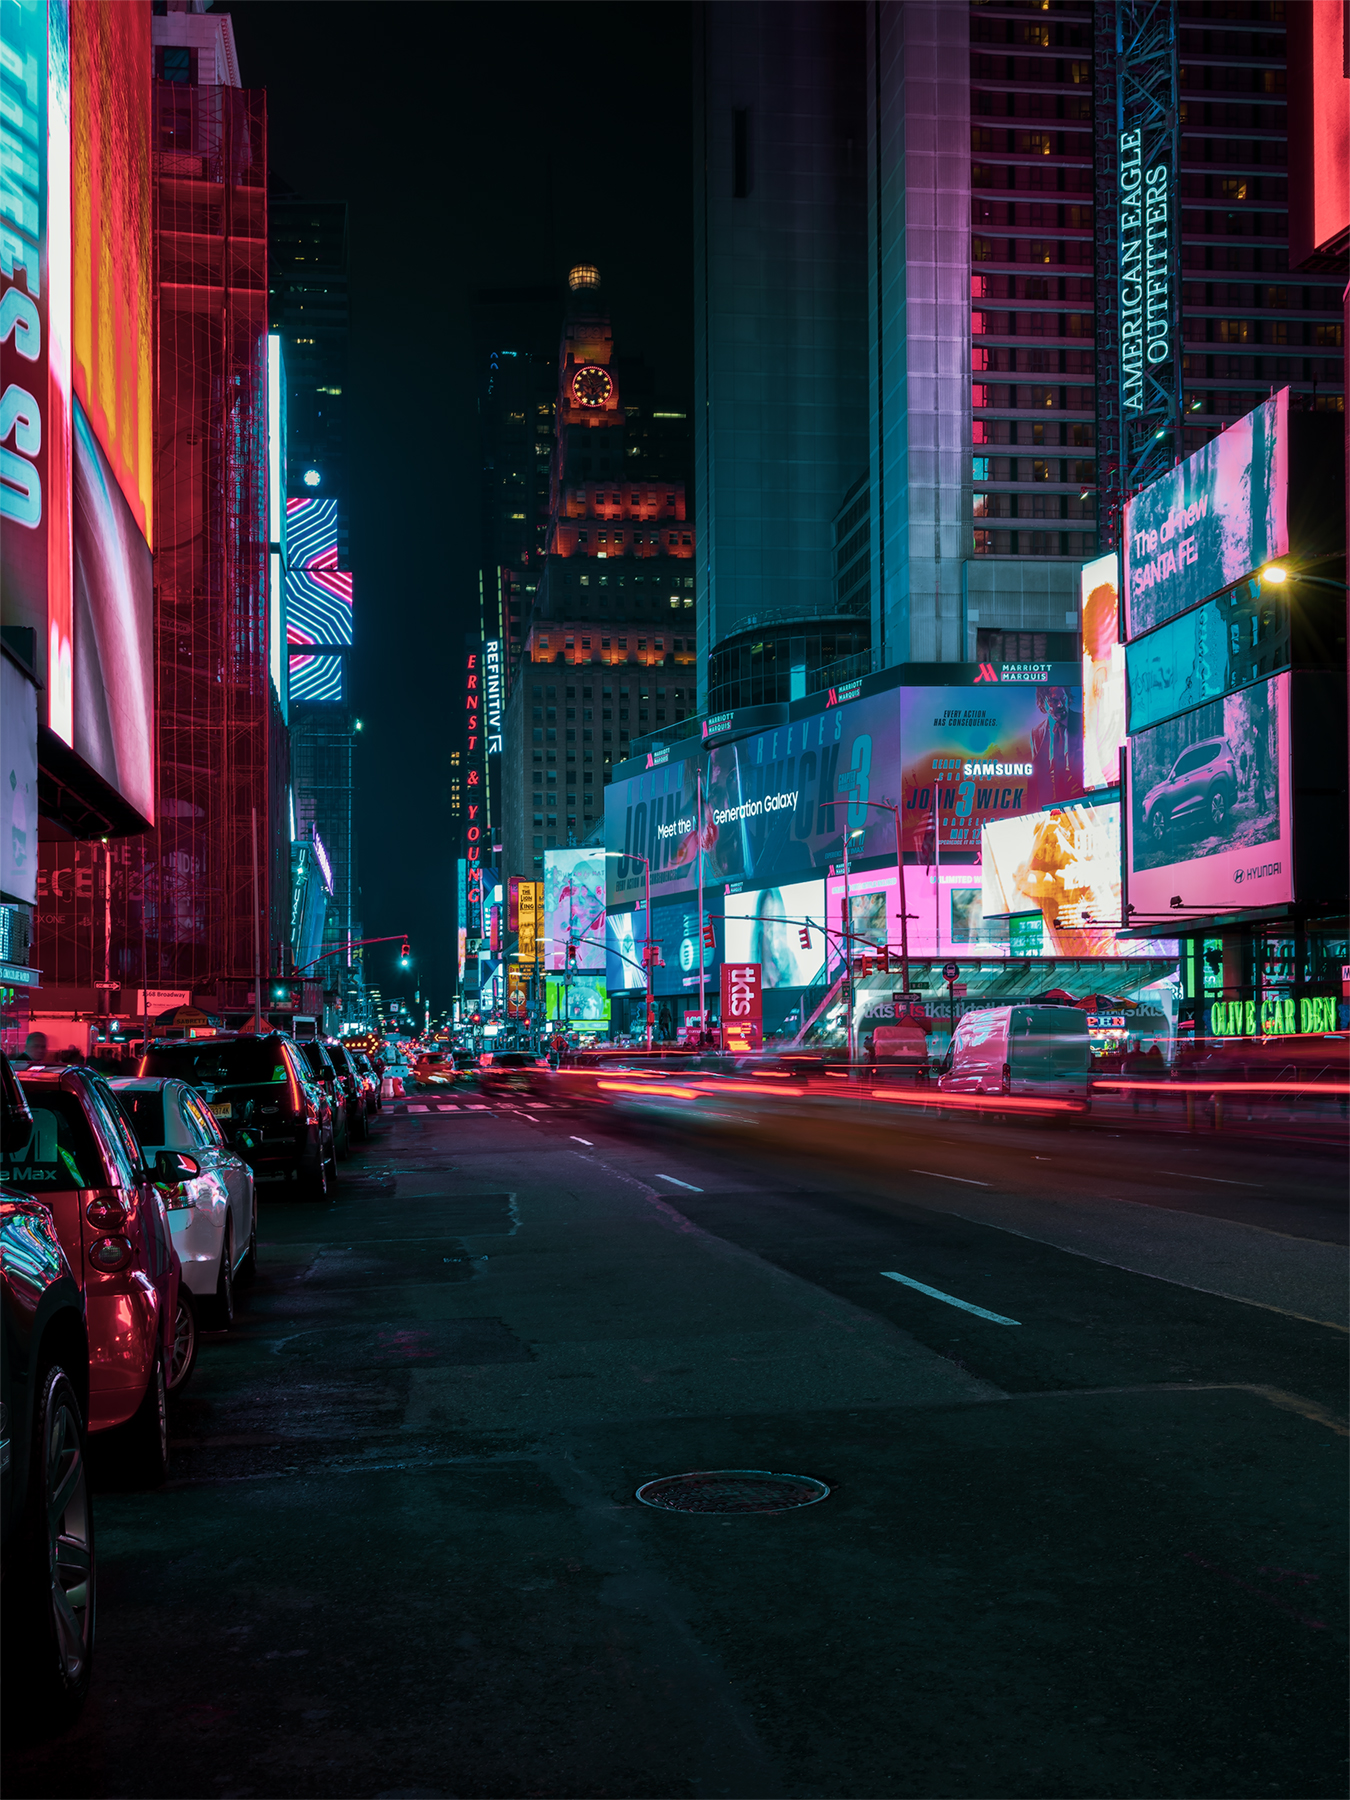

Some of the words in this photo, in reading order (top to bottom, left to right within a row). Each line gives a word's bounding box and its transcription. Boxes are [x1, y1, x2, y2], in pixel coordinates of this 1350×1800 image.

[1121, 128, 1143, 234] EAGLE
[1146, 165, 1169, 364] OUTFITTERS
[1122, 242, 1144, 411] AMERICAN
[1134, 529, 1158, 559] The
[1160, 494, 1209, 544] all-new
[1134, 548, 1177, 595] SANTA
[1178, 534, 1199, 571] FE
[1002, 664, 1053, 672] MARRIOTT
[1002, 672, 1047, 681] MARQUIS
[466, 653, 478, 752] ERNST
[487, 640, 502, 735] REFINITIV
[838, 679, 863, 694] MARRIOTT
[838, 688, 861, 702] MARQUIS
[708, 712, 735, 726] MARRIOTT
[708, 720, 732, 734] MARQUIS
[933, 718, 947, 727] HAS
[944, 710, 962, 718] EVERY
[963, 710, 987, 718] ACTION
[756, 710, 843, 765] REEVES
[847, 734, 873, 829] 3
[963, 763, 1034, 776] SAMSUNG
[657, 820, 677, 840] Meet
[678, 819, 692, 834] the
[713, 799, 763, 826] Generation
[764, 791, 799, 813] Galaxy
[907, 788, 956, 810] JON
[955, 781, 976, 817] 3
[976, 788, 1024, 810] WICK
[950, 828, 969, 840] MAY
[972, 828, 983, 840] 17
[467, 803, 481, 904] YOUNG
[1246, 861, 1282, 881] HYUNDAI
[519, 902, 534, 911] KING
[731, 967, 756, 1016] tkts
[1210, 1000, 1256, 1036] OLIVE
[12, 1166, 57, 1181] Max
